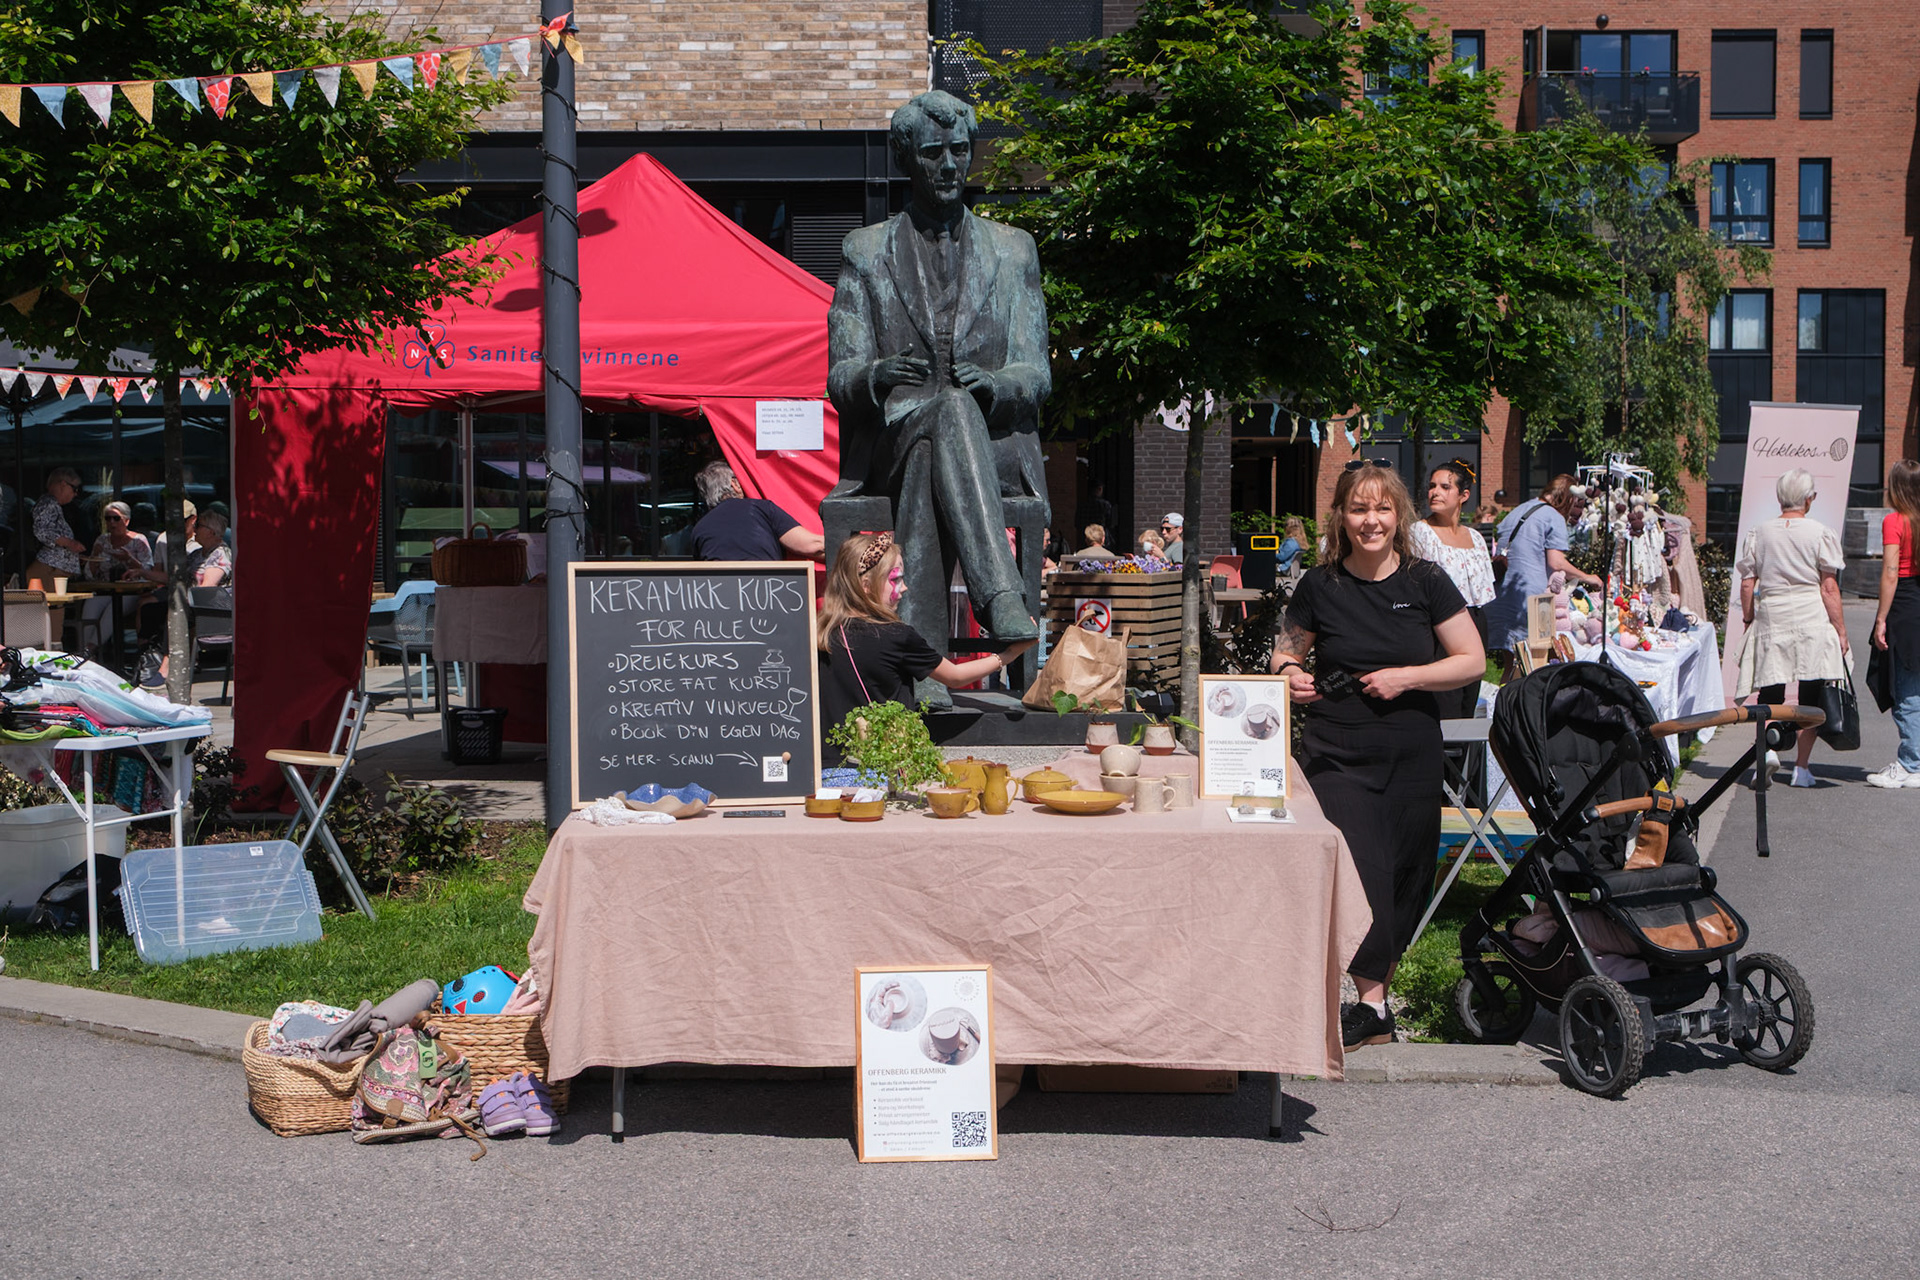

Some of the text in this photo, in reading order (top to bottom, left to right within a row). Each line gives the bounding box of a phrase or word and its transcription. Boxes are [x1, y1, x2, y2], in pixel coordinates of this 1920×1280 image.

[466, 345, 680, 367] Sanitevinnene
[589, 578, 804, 614] KERAMIKK KURS
[635, 619, 746, 642] FOR ALLE
[617, 675, 780, 694] STORE FAT KURS
[720, 724, 761, 739] EGEN
[770, 723, 801, 741] DAG
[599, 754, 620, 771] SE
[671, 753, 715, 767] SCANN
[910, 1067, 947, 1075] KERAMIKK
